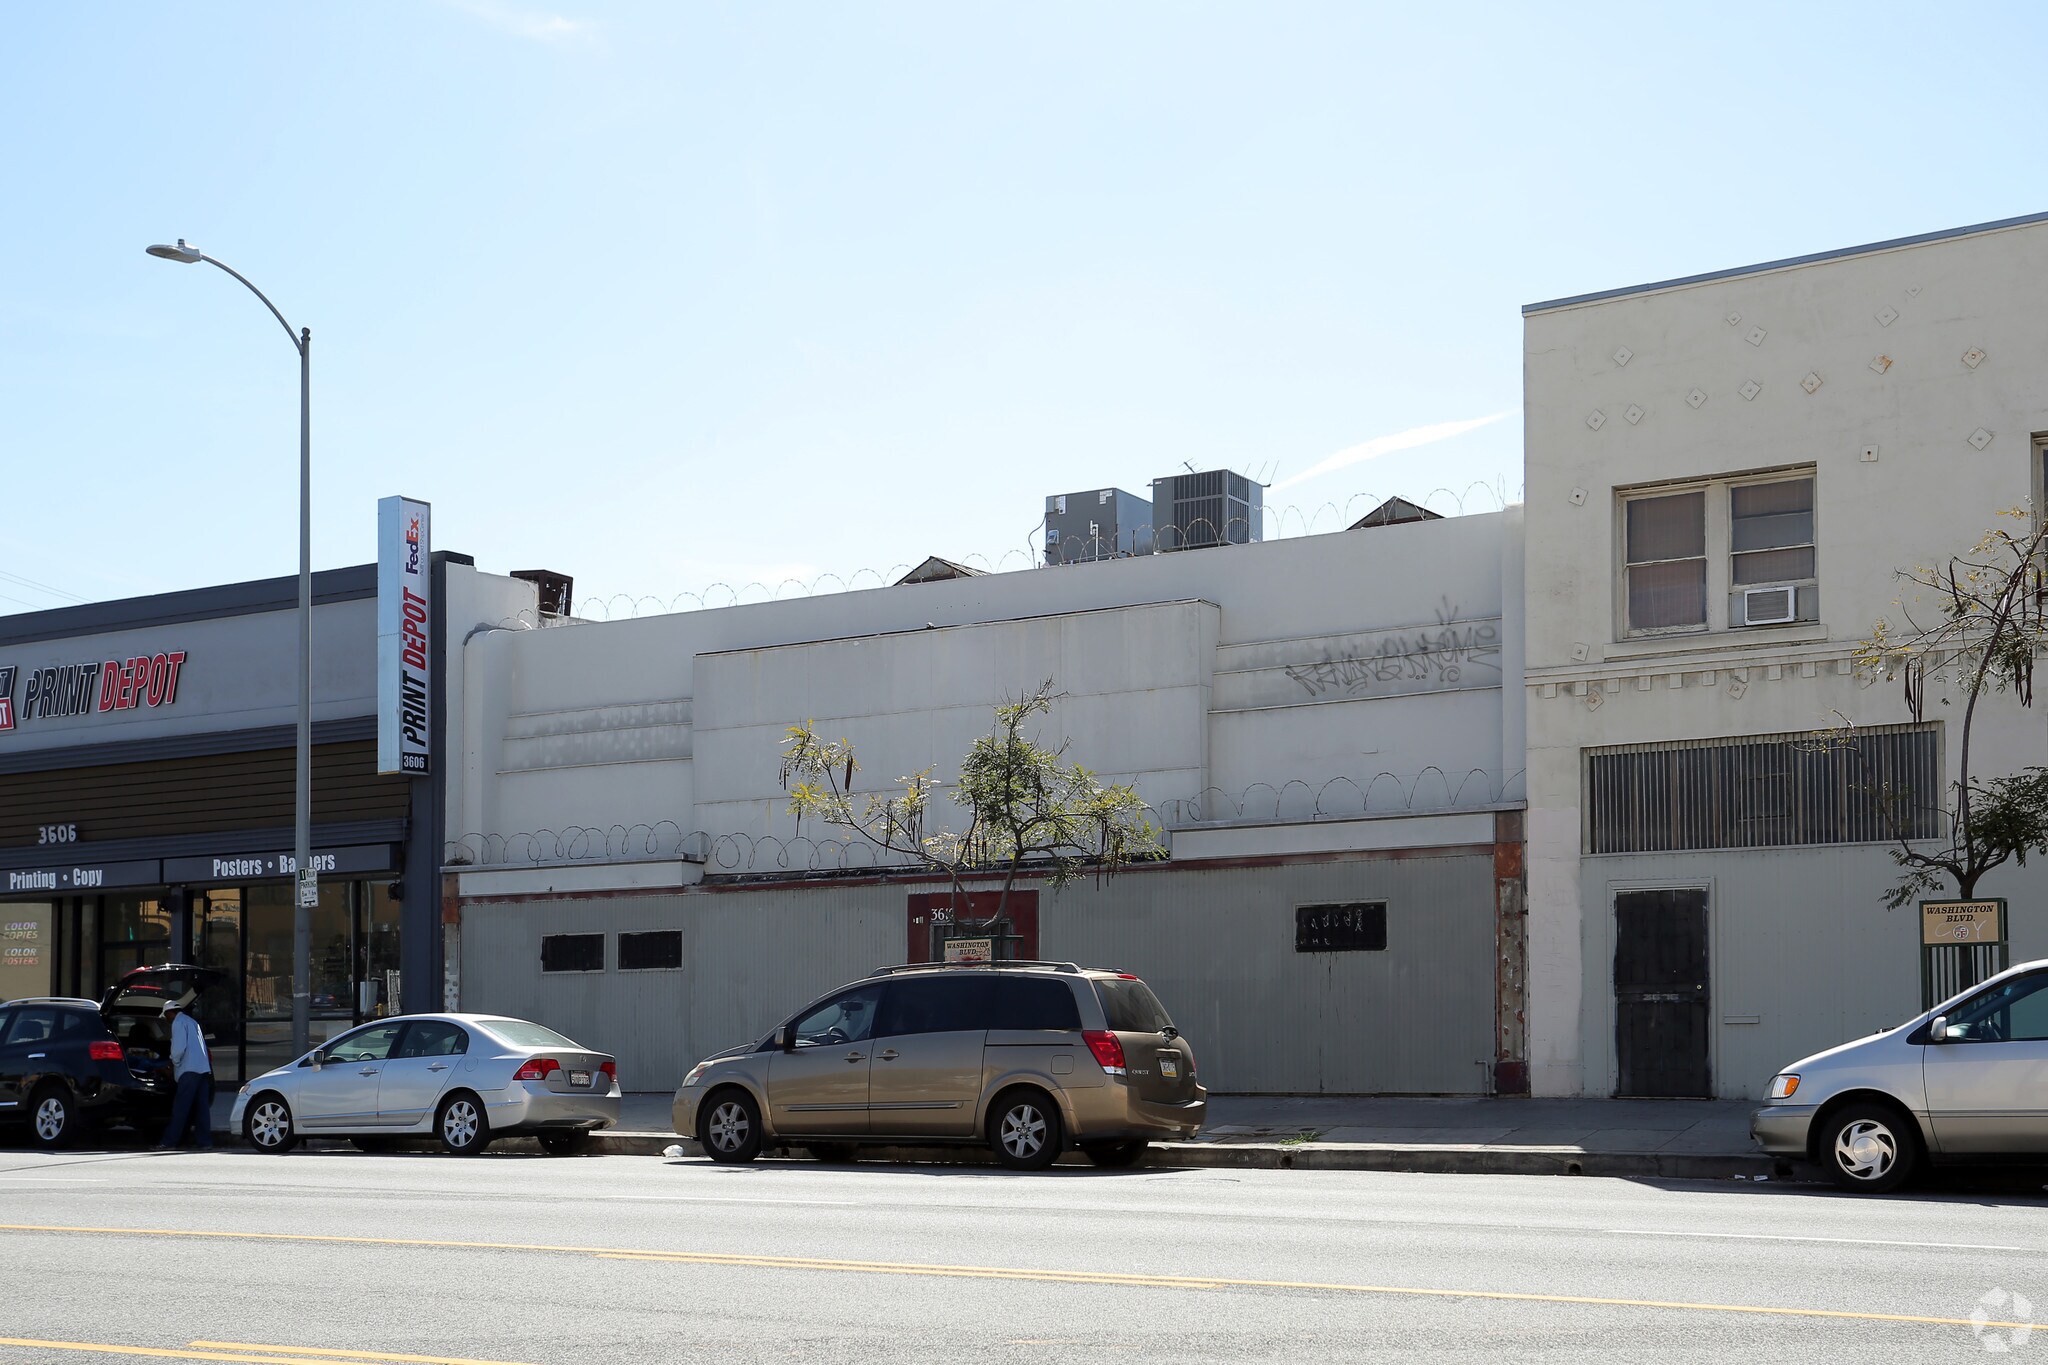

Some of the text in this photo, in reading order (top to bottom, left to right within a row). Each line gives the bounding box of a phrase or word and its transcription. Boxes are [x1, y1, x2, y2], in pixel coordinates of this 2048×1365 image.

[406, 517, 419, 575] FedEx
[21, 663, 98, 720] PRINT
[403, 669, 426, 747] PRINT
[403, 755, 425, 769] 3606
[38, 824, 77, 844] 3606
[213, 854, 336, 877] Posters Baers
[10, 867, 103, 890] Printing Copy
[1926, 904, 1994, 915] WASHINGTON
[1945, 914, 1976, 923] BLVD.
[4, 921, 38, 931] COLOR
[3, 930, 39, 940] COPIES
[946, 941, 990, 949] WASHINGTON
[4, 947, 37, 957] COLOR
[2, 956, 39, 966] POSTERS
